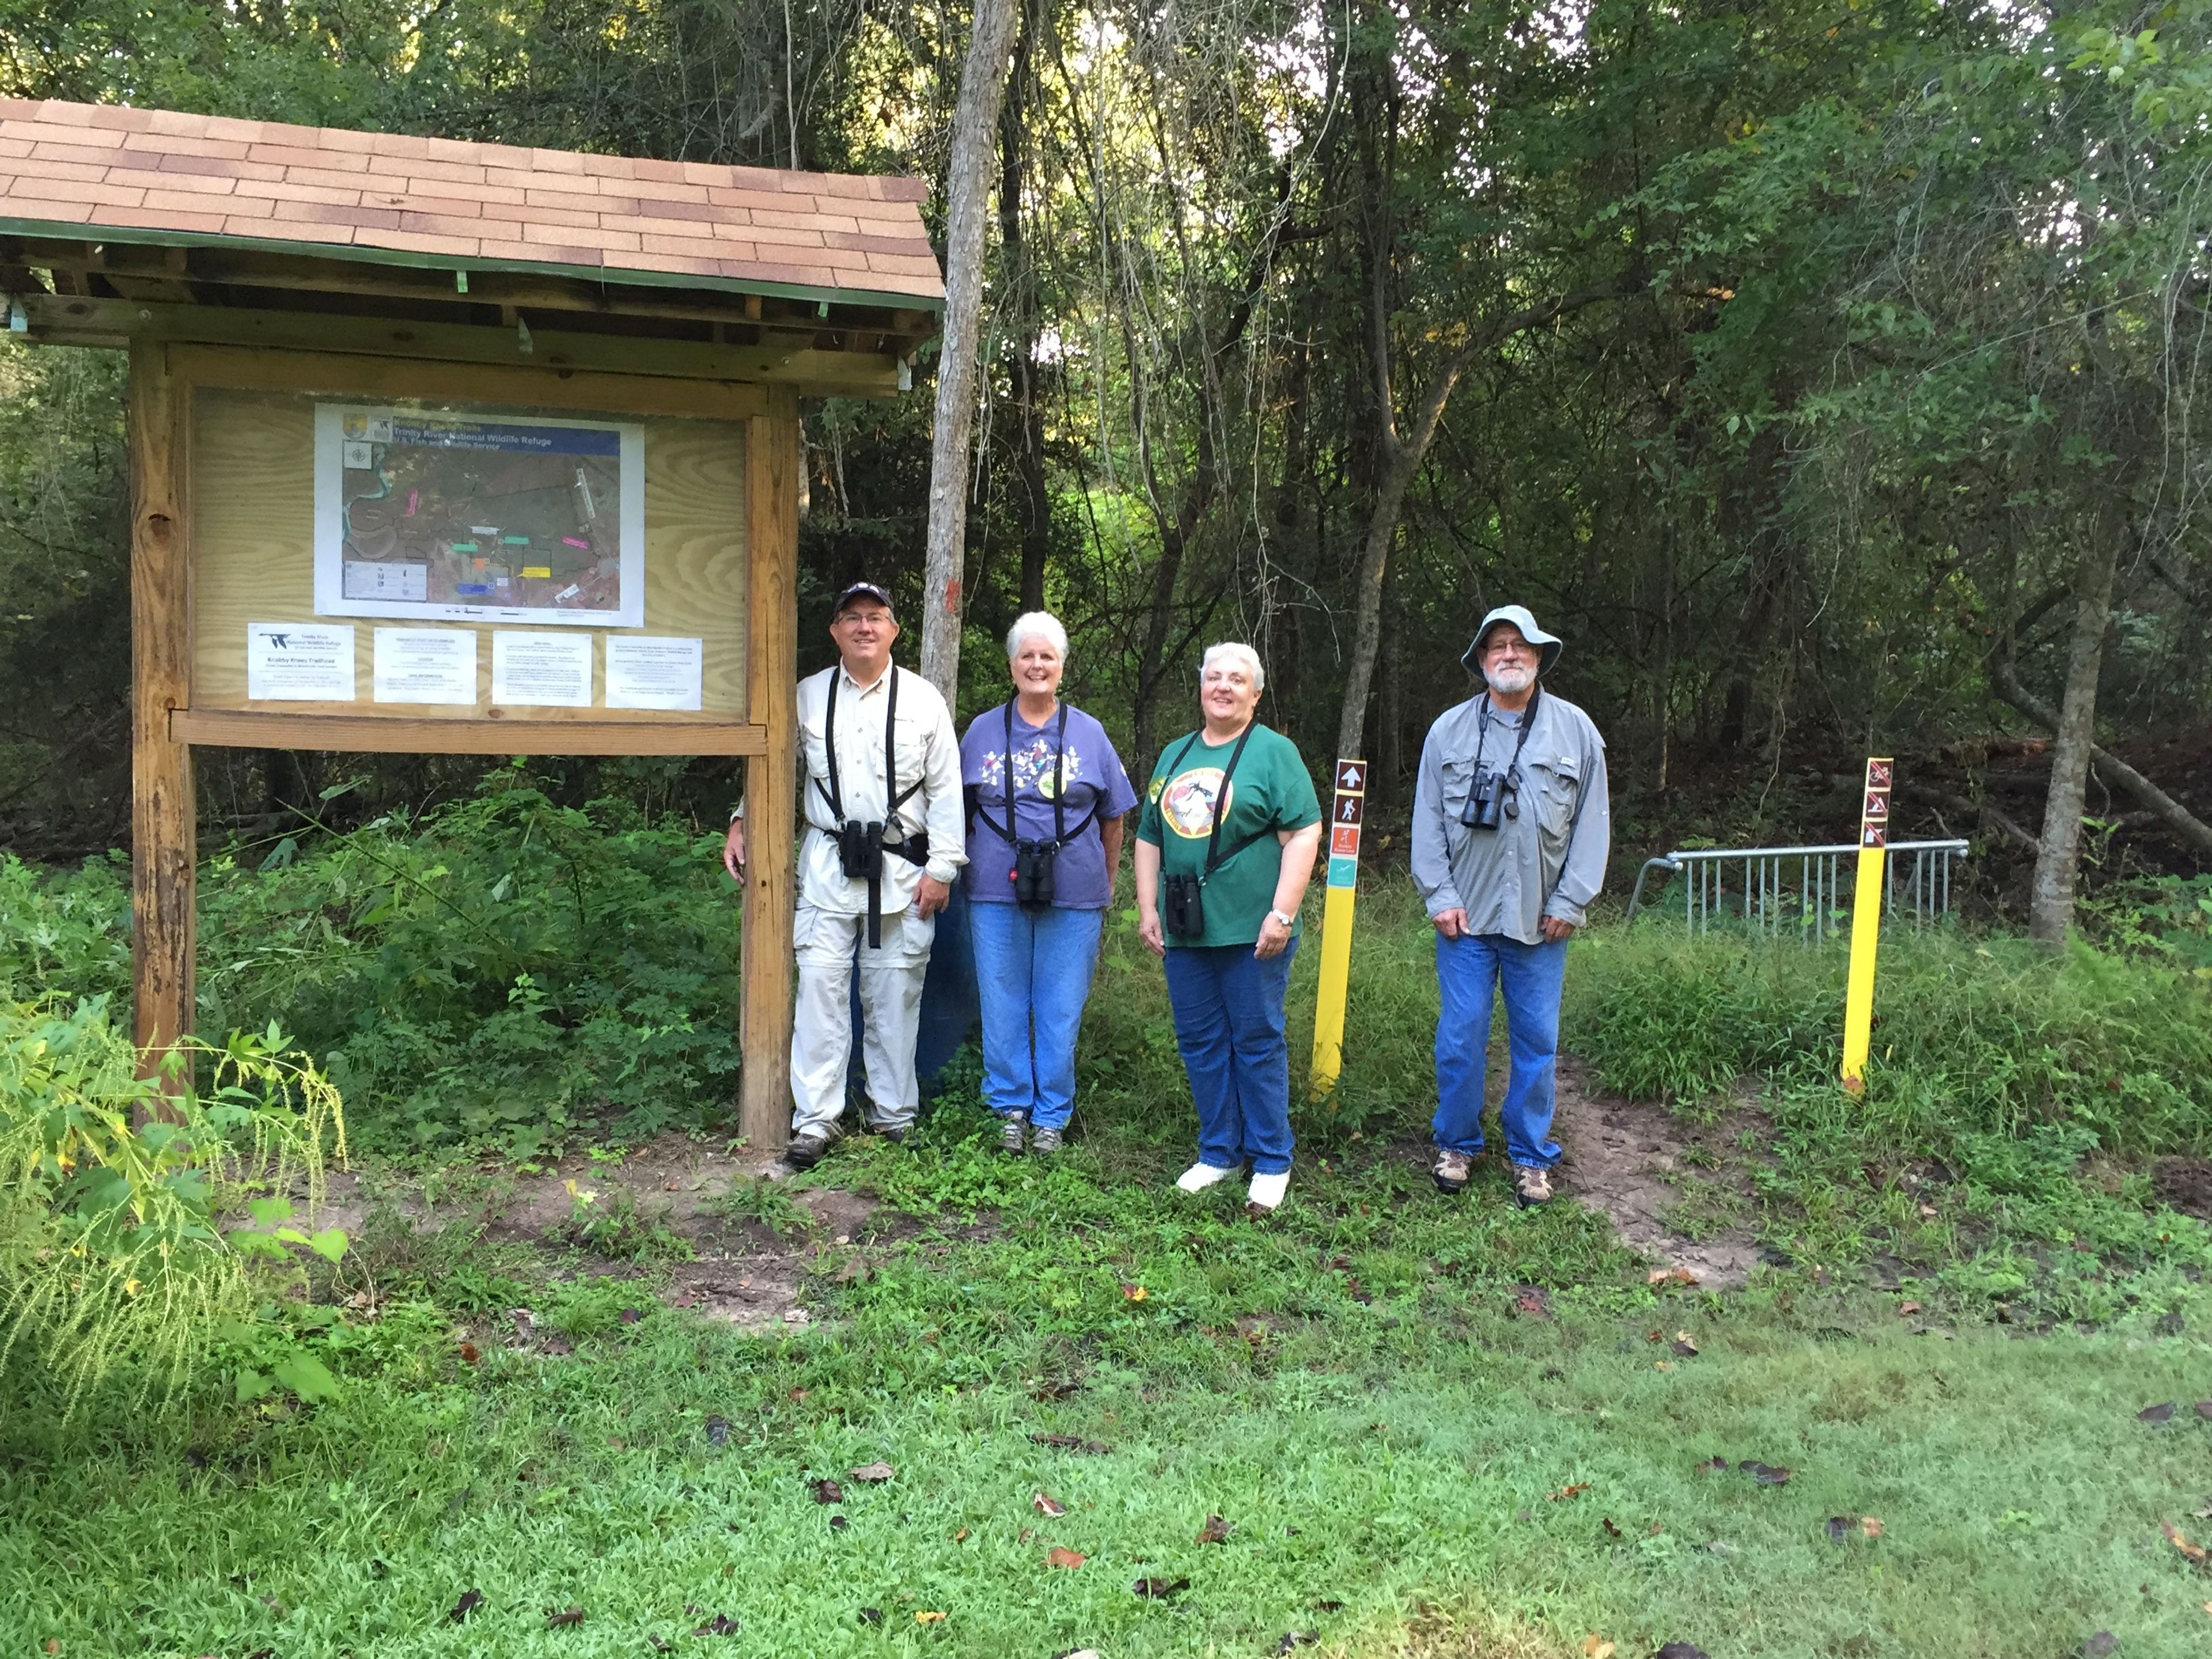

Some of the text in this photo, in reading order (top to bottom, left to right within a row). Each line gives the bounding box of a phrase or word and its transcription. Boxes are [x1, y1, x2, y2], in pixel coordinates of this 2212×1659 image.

[394, 427, 421, 438] Trinity
[423, 430, 446, 438] River
[449, 431, 484, 442] National
[487, 433, 519, 444] Wildlife
[521, 436, 552, 448] Refuge
[473, 441, 501, 450] Service
